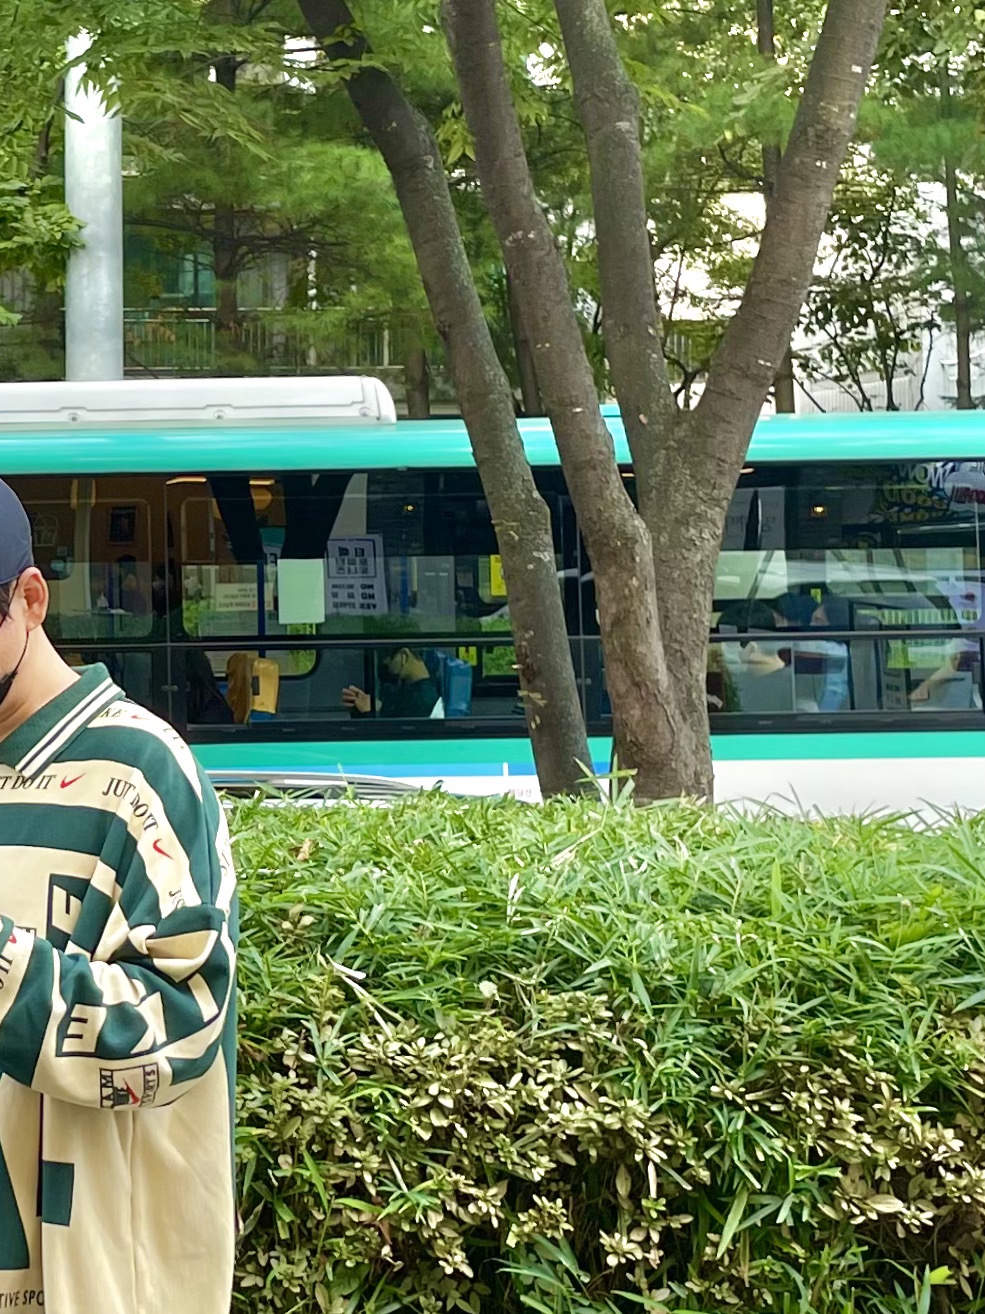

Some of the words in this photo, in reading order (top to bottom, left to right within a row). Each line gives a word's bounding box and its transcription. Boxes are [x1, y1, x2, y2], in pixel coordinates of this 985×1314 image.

[11, 775, 34, 790] DO
[35, 774, 57, 790] IT
[22, 1289, 44, 1307] SPO
